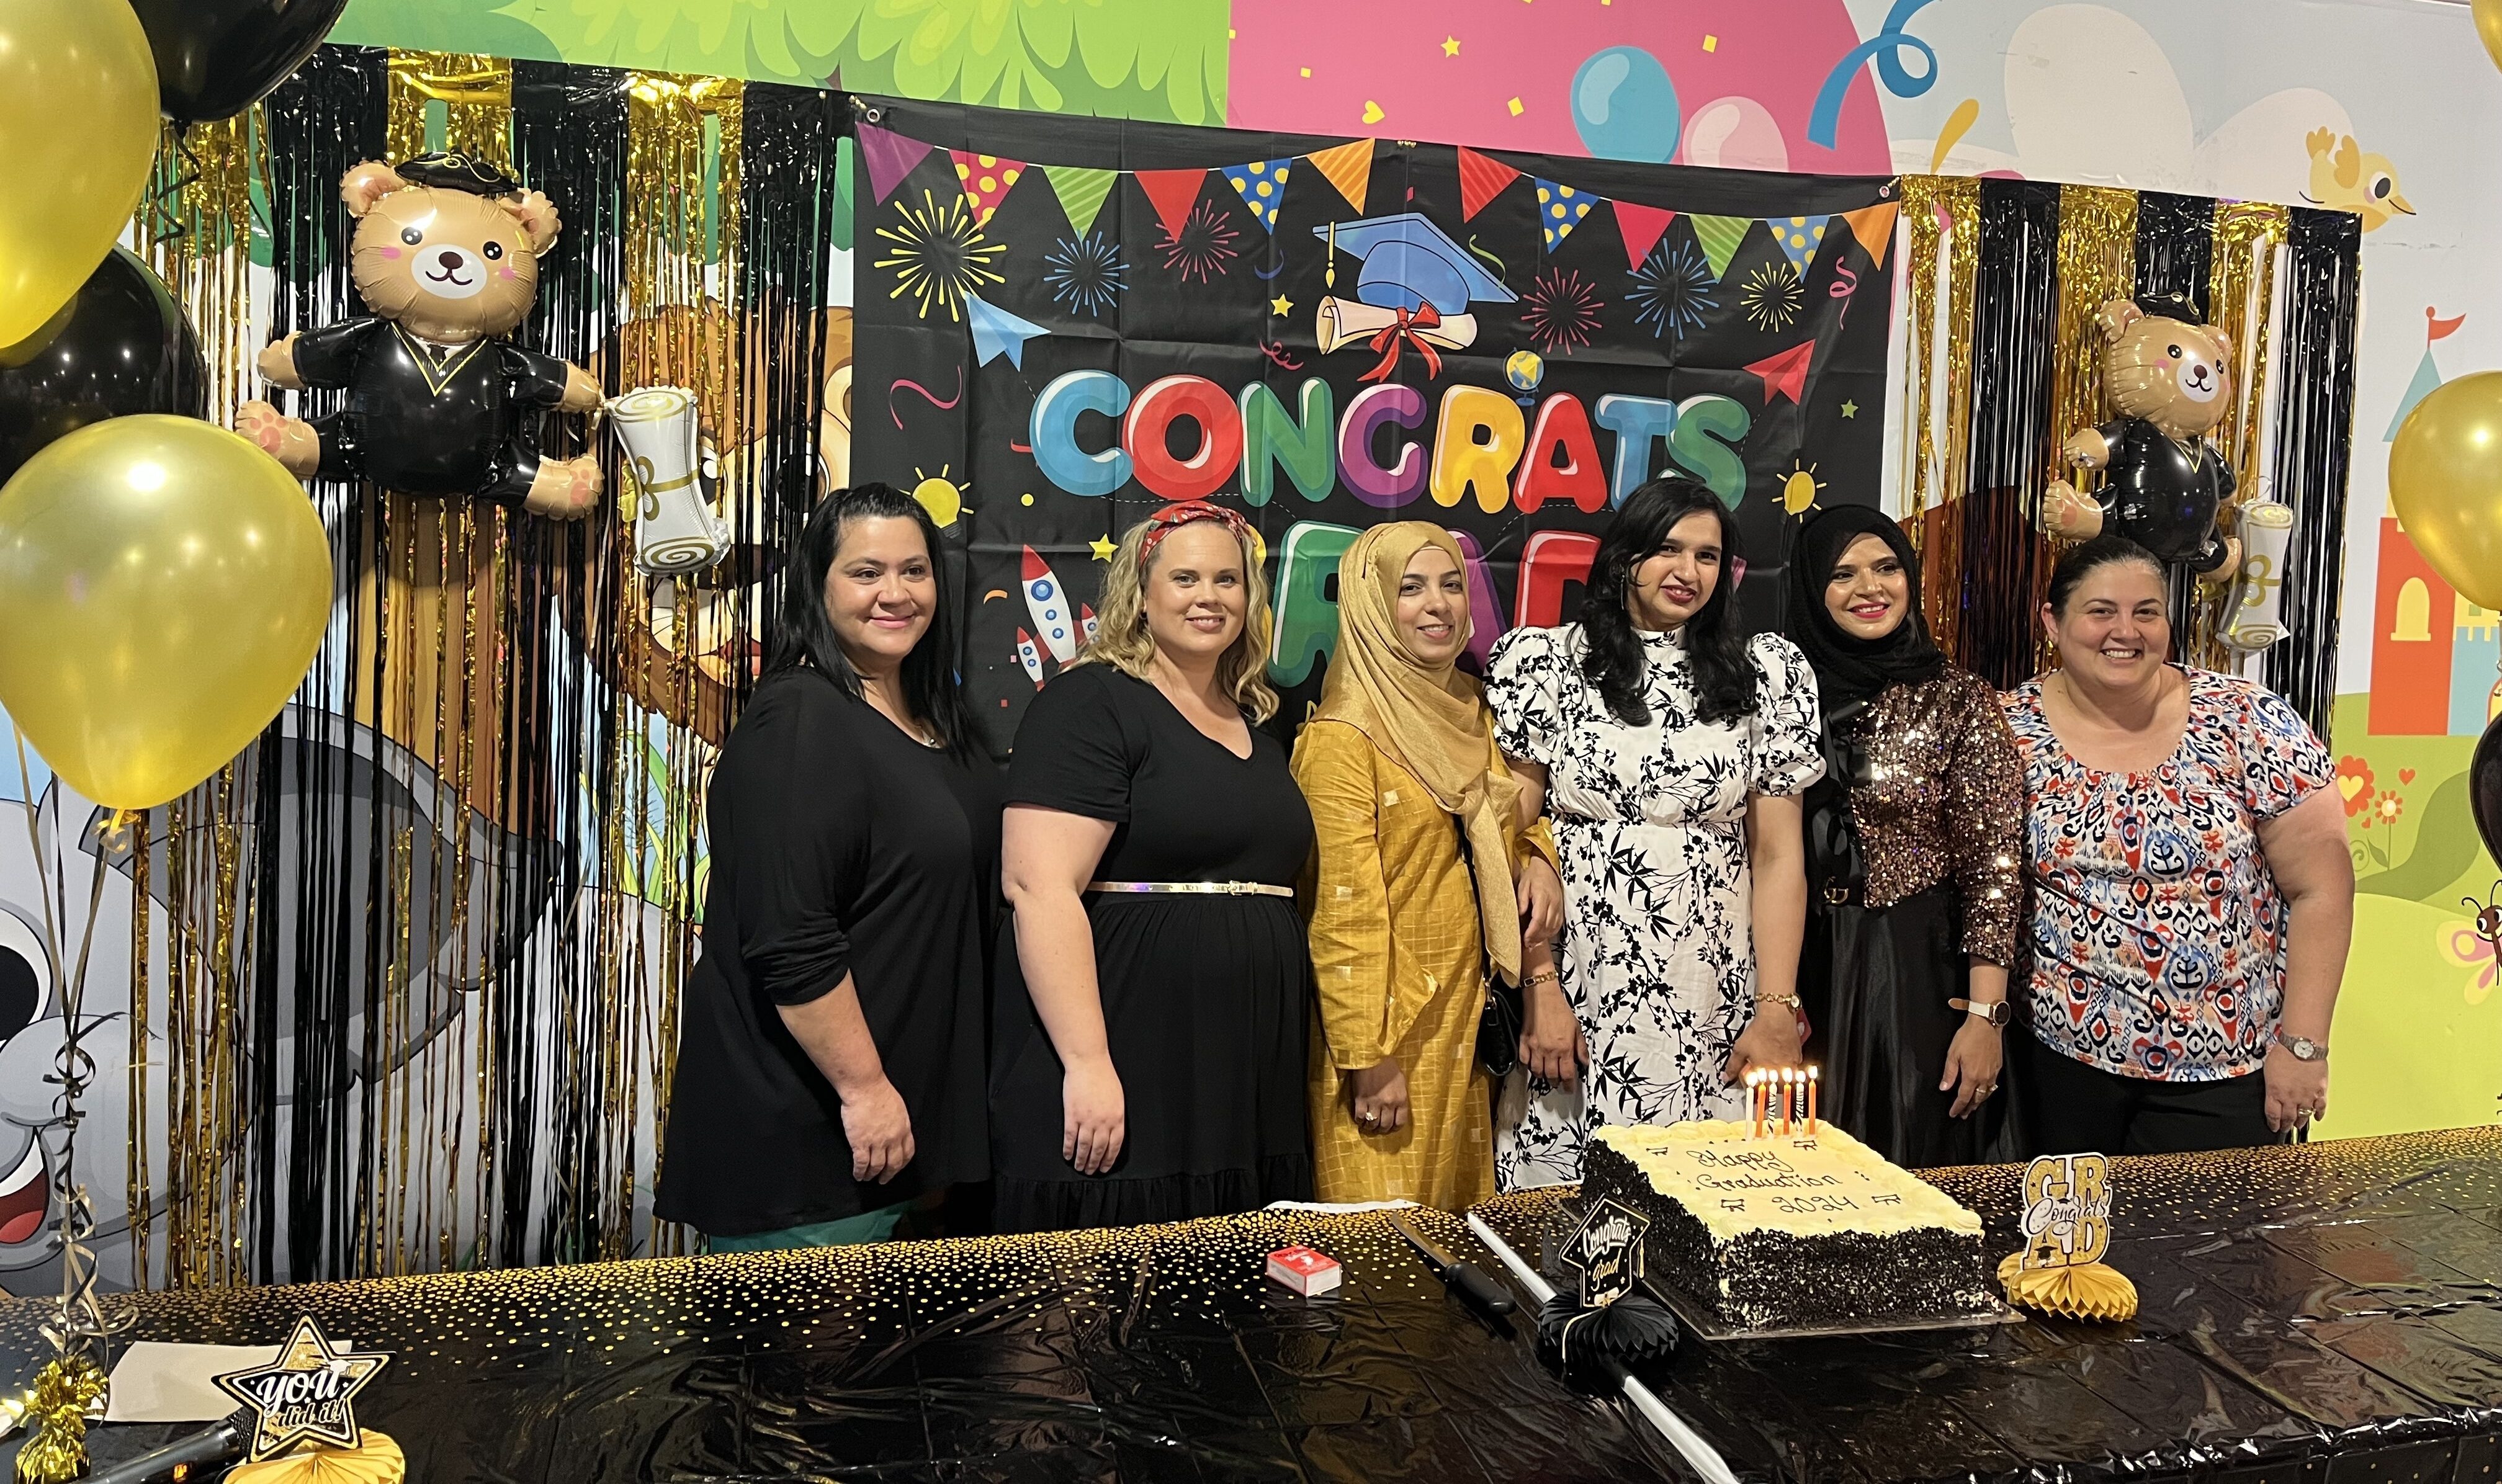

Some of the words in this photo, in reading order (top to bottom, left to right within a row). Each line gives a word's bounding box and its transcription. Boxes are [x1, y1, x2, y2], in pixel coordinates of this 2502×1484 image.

[1029, 369, 1751, 514] CONGRATS
[1687, 1150, 1794, 1173] Happy
[1696, 1173, 1843, 1191] Graduation
[1772, 1195, 1860, 1214] 2024
[2026, 1194, 2106, 1236] Congrats
[1583, 1215, 1632, 1259] Congrats
[1590, 1248, 1623, 1292] grad
[256, 1368, 341, 1419] you
[277, 1403, 316, 1428] did
[318, 1398, 346, 1423] it!
